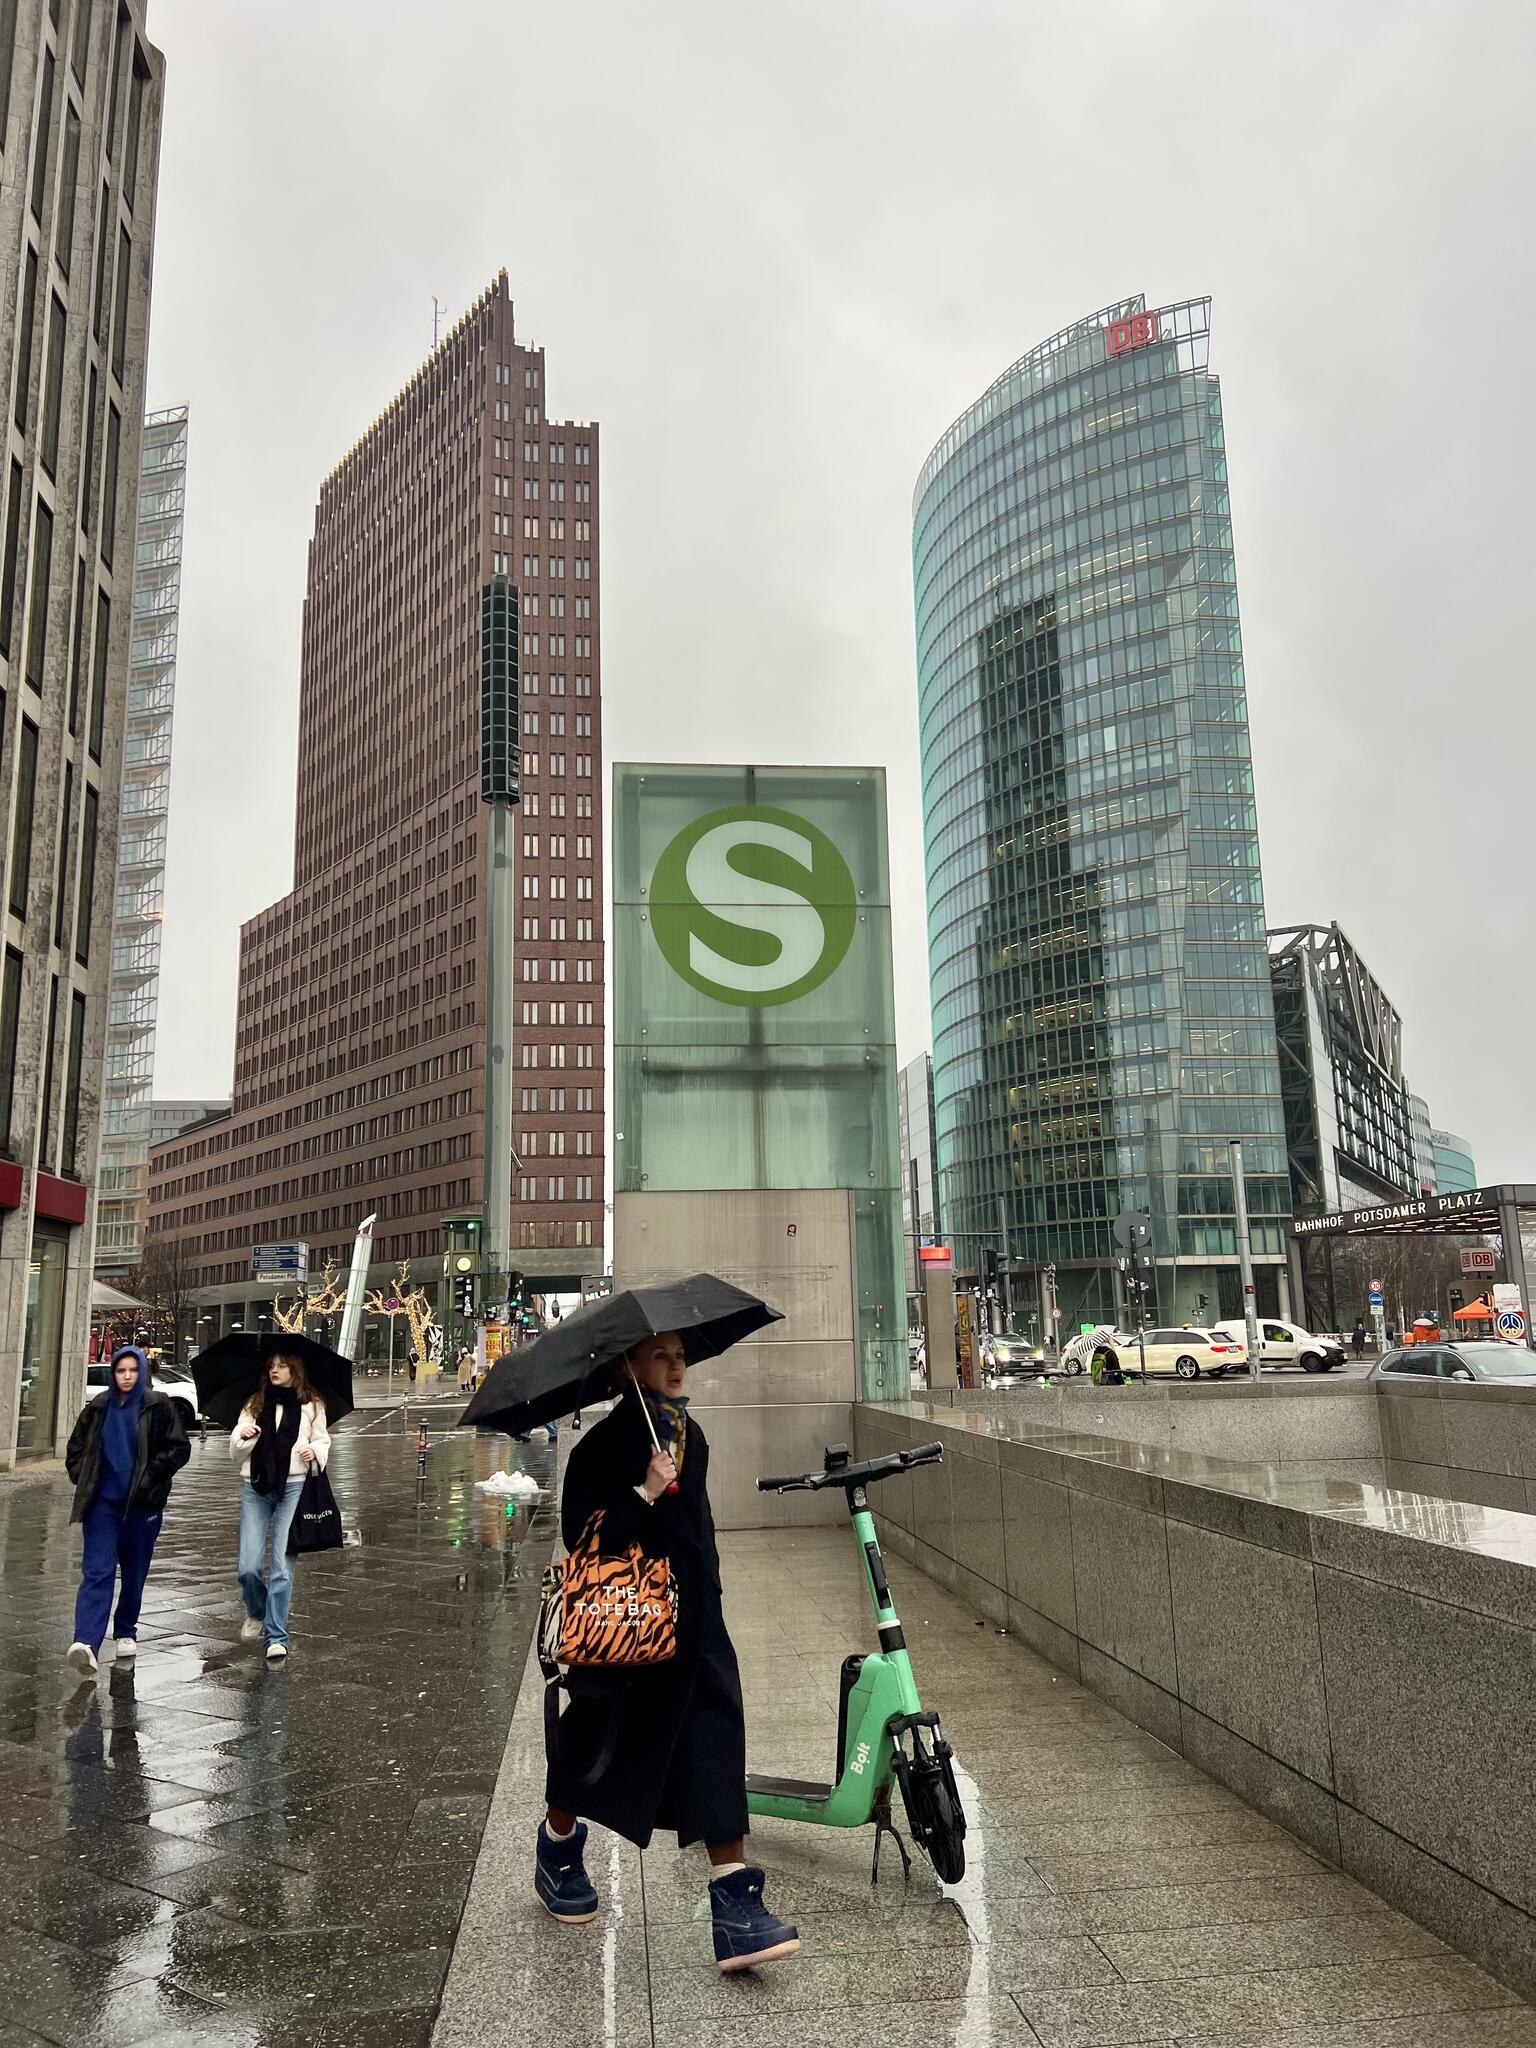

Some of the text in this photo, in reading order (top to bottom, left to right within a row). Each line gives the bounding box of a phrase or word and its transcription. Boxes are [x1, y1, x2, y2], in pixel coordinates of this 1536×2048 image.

[1111, 316, 1151, 350] DB
[686, 821, 825, 992] S
[1295, 1192, 1483, 1233] BAHNHOF POTSDAMER PLATZ
[1475, 1254, 1490, 1264] DB
[602, 1586, 637, 1599] THE
[595, 1619, 615, 1627] MARC
[850, 1742, 871, 1775] Bolt
